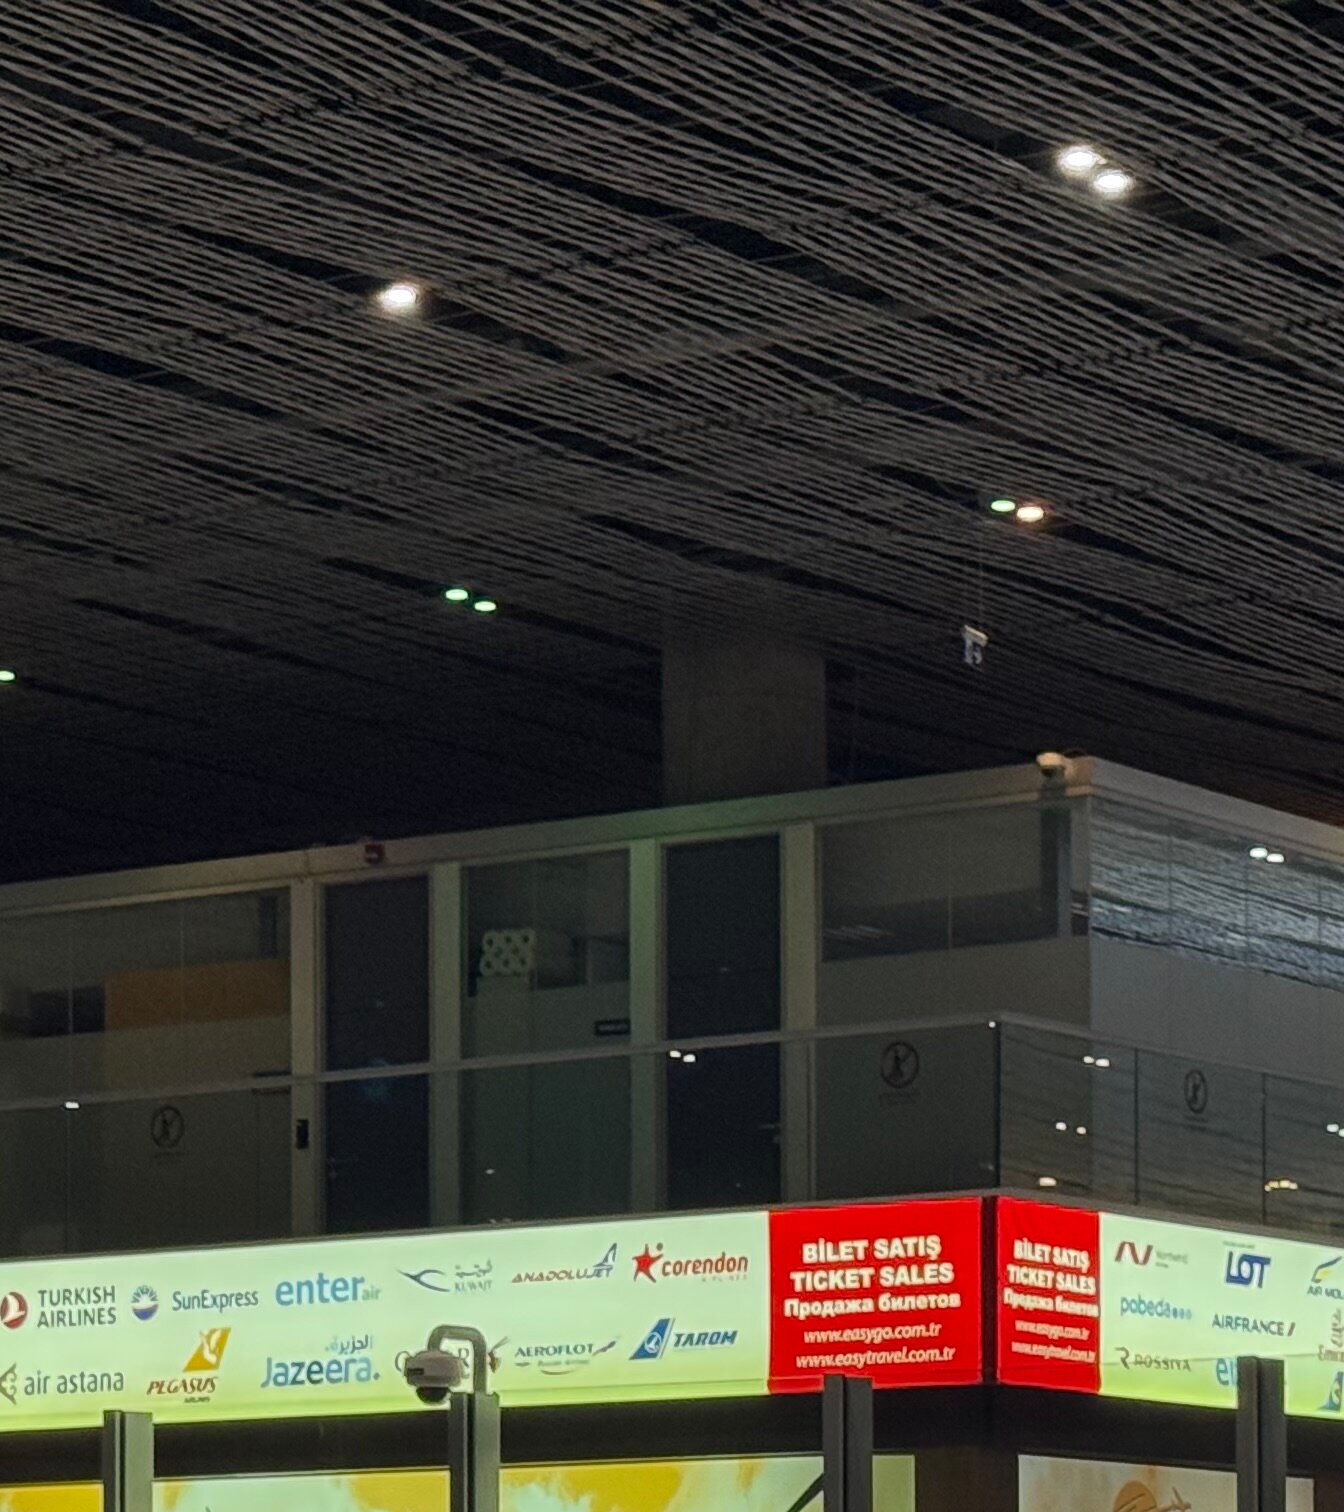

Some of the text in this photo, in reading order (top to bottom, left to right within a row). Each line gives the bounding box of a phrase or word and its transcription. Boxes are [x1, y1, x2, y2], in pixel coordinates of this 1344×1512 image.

[802, 1235, 942, 1264] BİLET SATIŞ
[1013, 1237, 1090, 1273] BİLET SATIŞ
[662, 1252, 748, 1277] corendon
[1226, 1251, 1271, 1289] LOT
[789, 1262, 955, 1292] TICKET SALES
[1007, 1264, 1096, 1295] TICKET SALES
[37, 1286, 116, 1306] TURKISH
[172, 1290, 259, 1313] SunExpress
[275, 1273, 365, 1306] enter
[37, 1307, 117, 1329] AIRLINES
[784, 1292, 961, 1320] Продажа билетов
[803, 1322, 942, 1344] www.easygo.com.tr
[1212, 1313, 1285, 1336] AIRFRANCE
[515, 1343, 594, 1358] AEROFLOT
[674, 1330, 738, 1348] TAROM
[23, 1371, 124, 1395] air astana
[146, 1376, 218, 1396] PEGASUS
